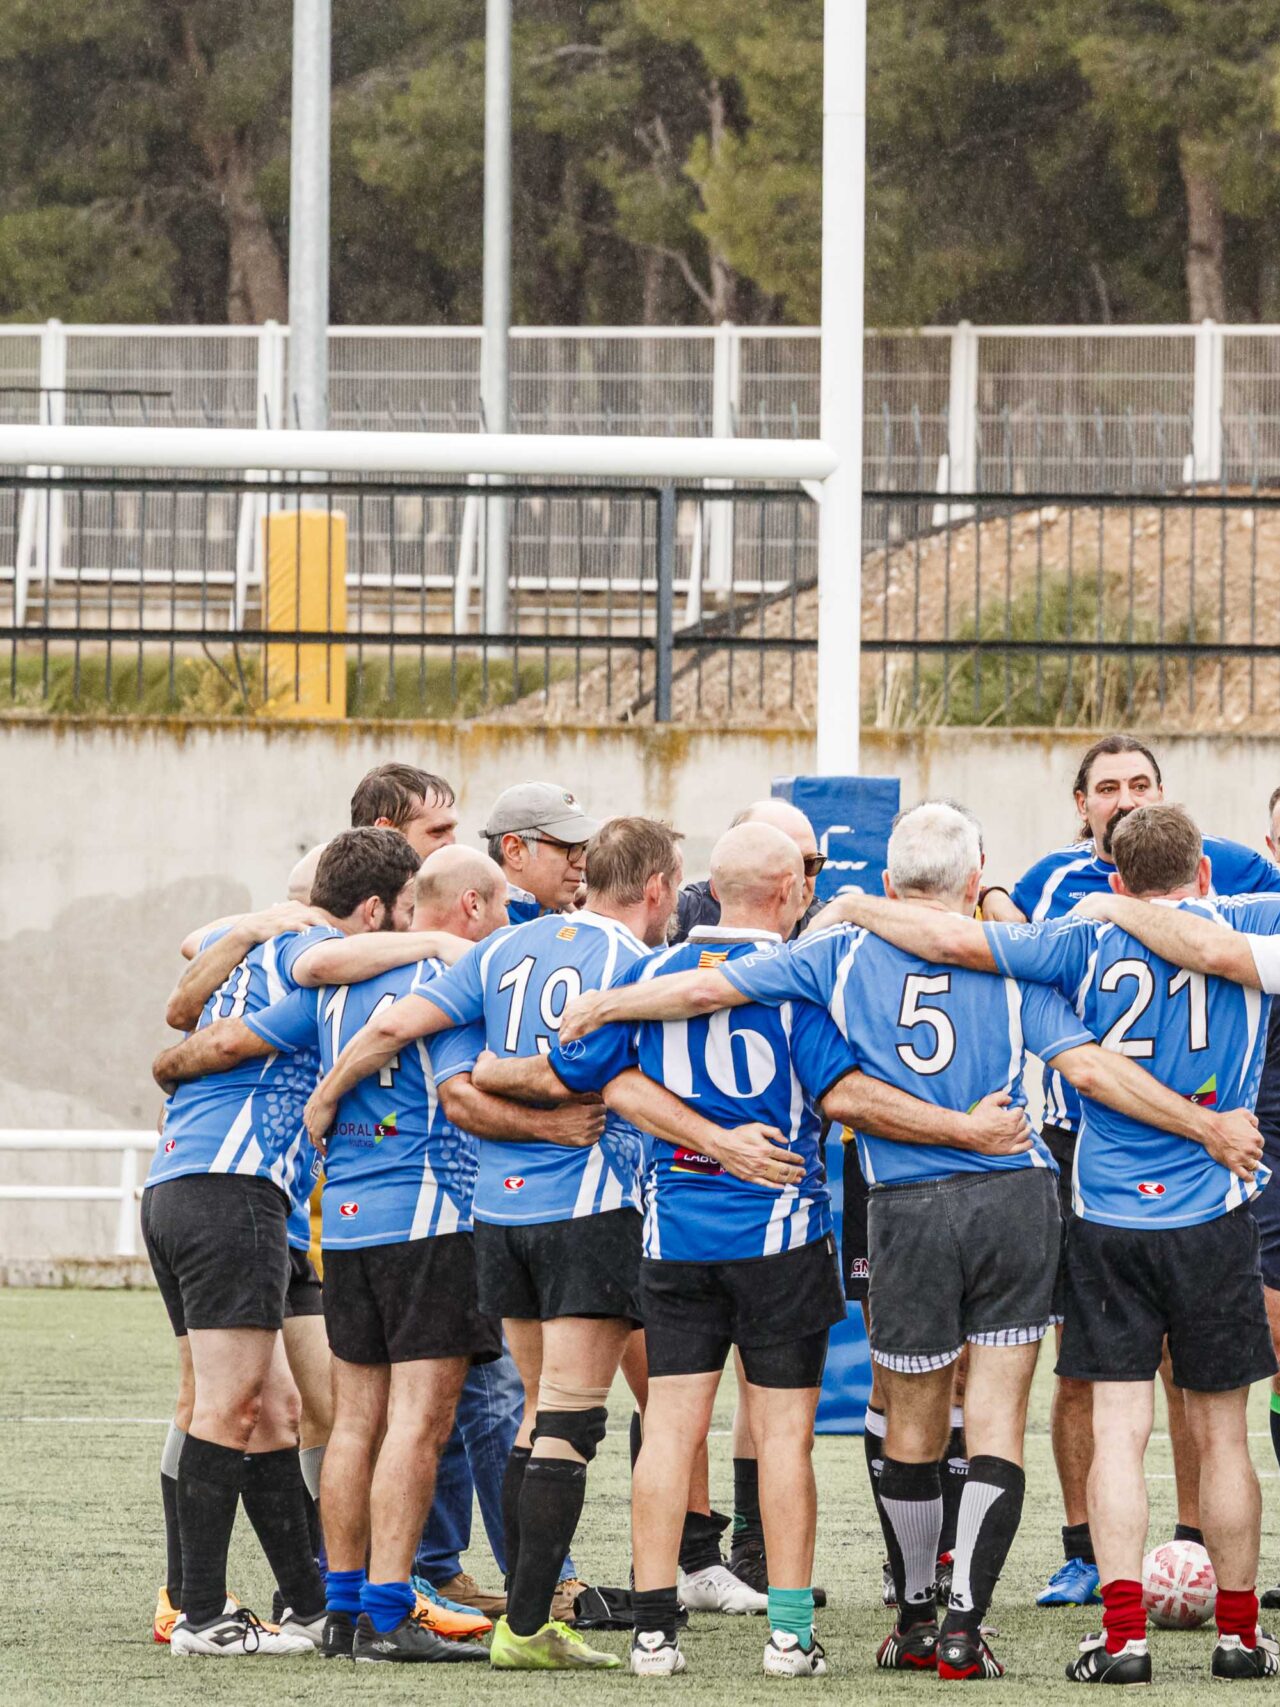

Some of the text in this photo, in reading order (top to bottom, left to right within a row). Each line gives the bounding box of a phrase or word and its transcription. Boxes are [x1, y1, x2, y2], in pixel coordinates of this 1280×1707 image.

[497, 954, 582, 1055] 19
[662, 1007, 777, 1098] 16
[895, 972, 956, 1076] 5
[1098, 957, 1209, 1059] 21
